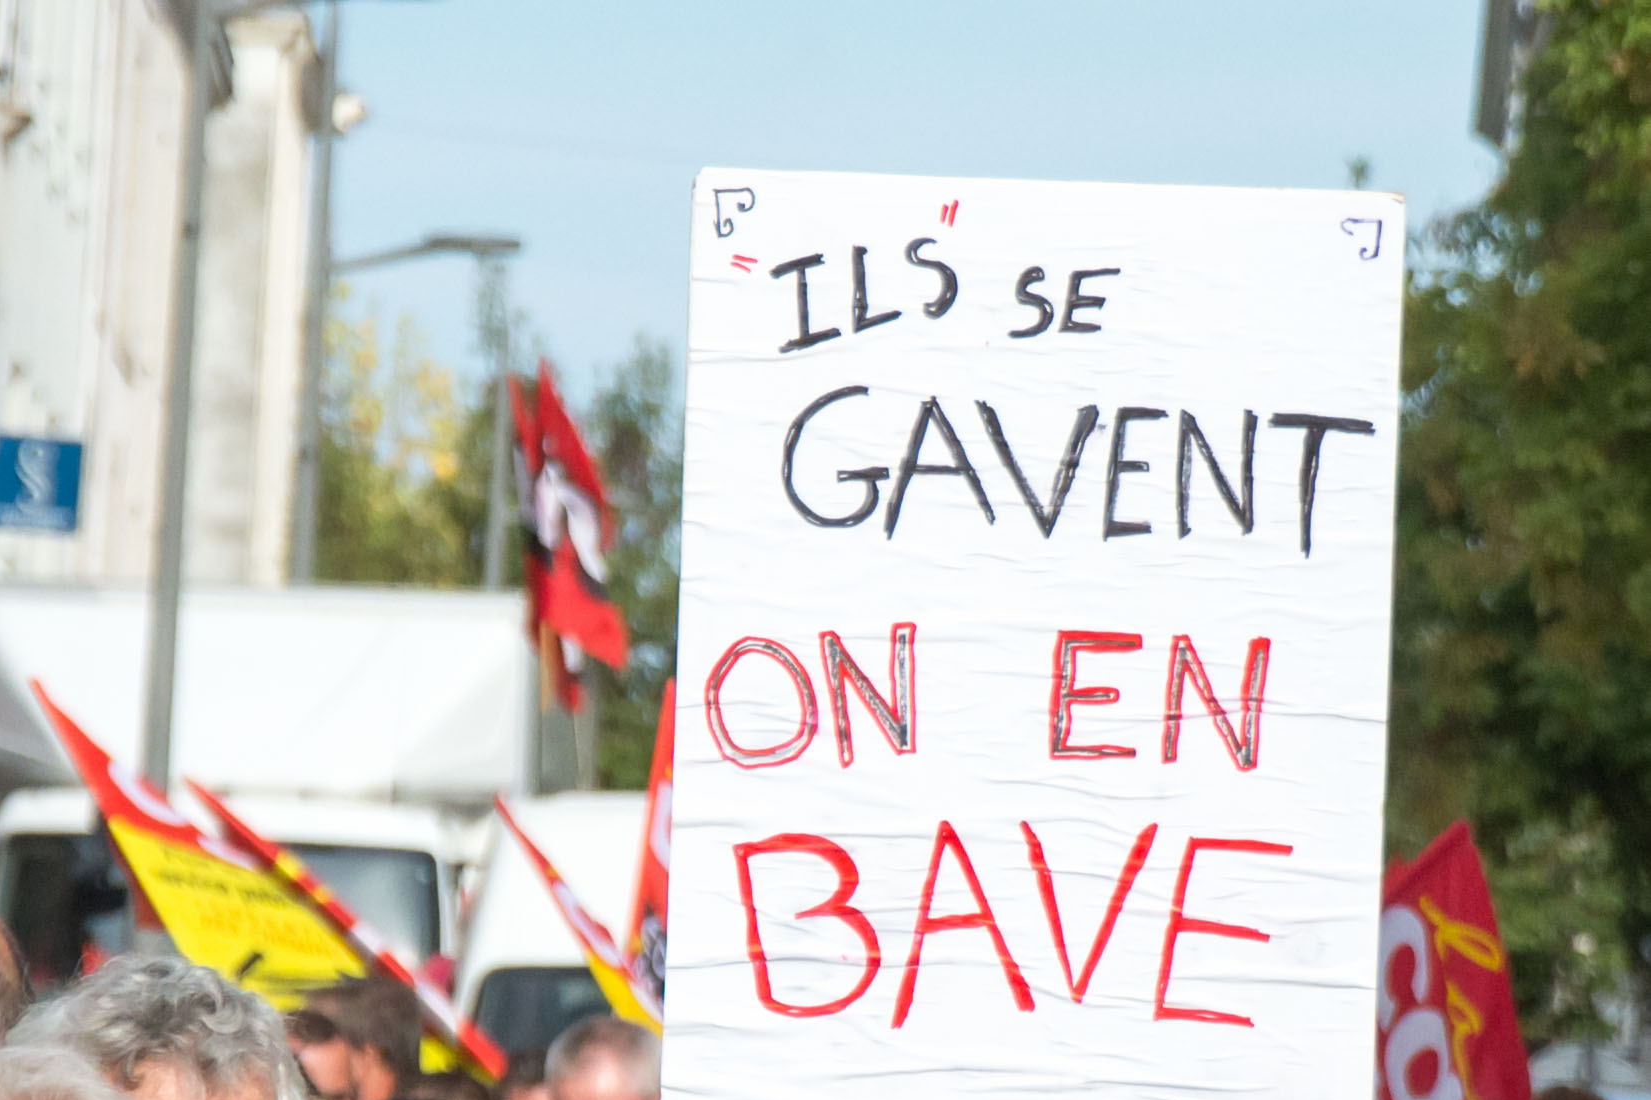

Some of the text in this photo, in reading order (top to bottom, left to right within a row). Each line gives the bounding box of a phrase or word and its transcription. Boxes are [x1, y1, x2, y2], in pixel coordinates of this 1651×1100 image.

[1008, 265, 1121, 338] SE
[781, 385, 1376, 559] GAVENT
[705, 622, 1271, 774] ON EN
[733, 820, 1293, 1029] BAVE
